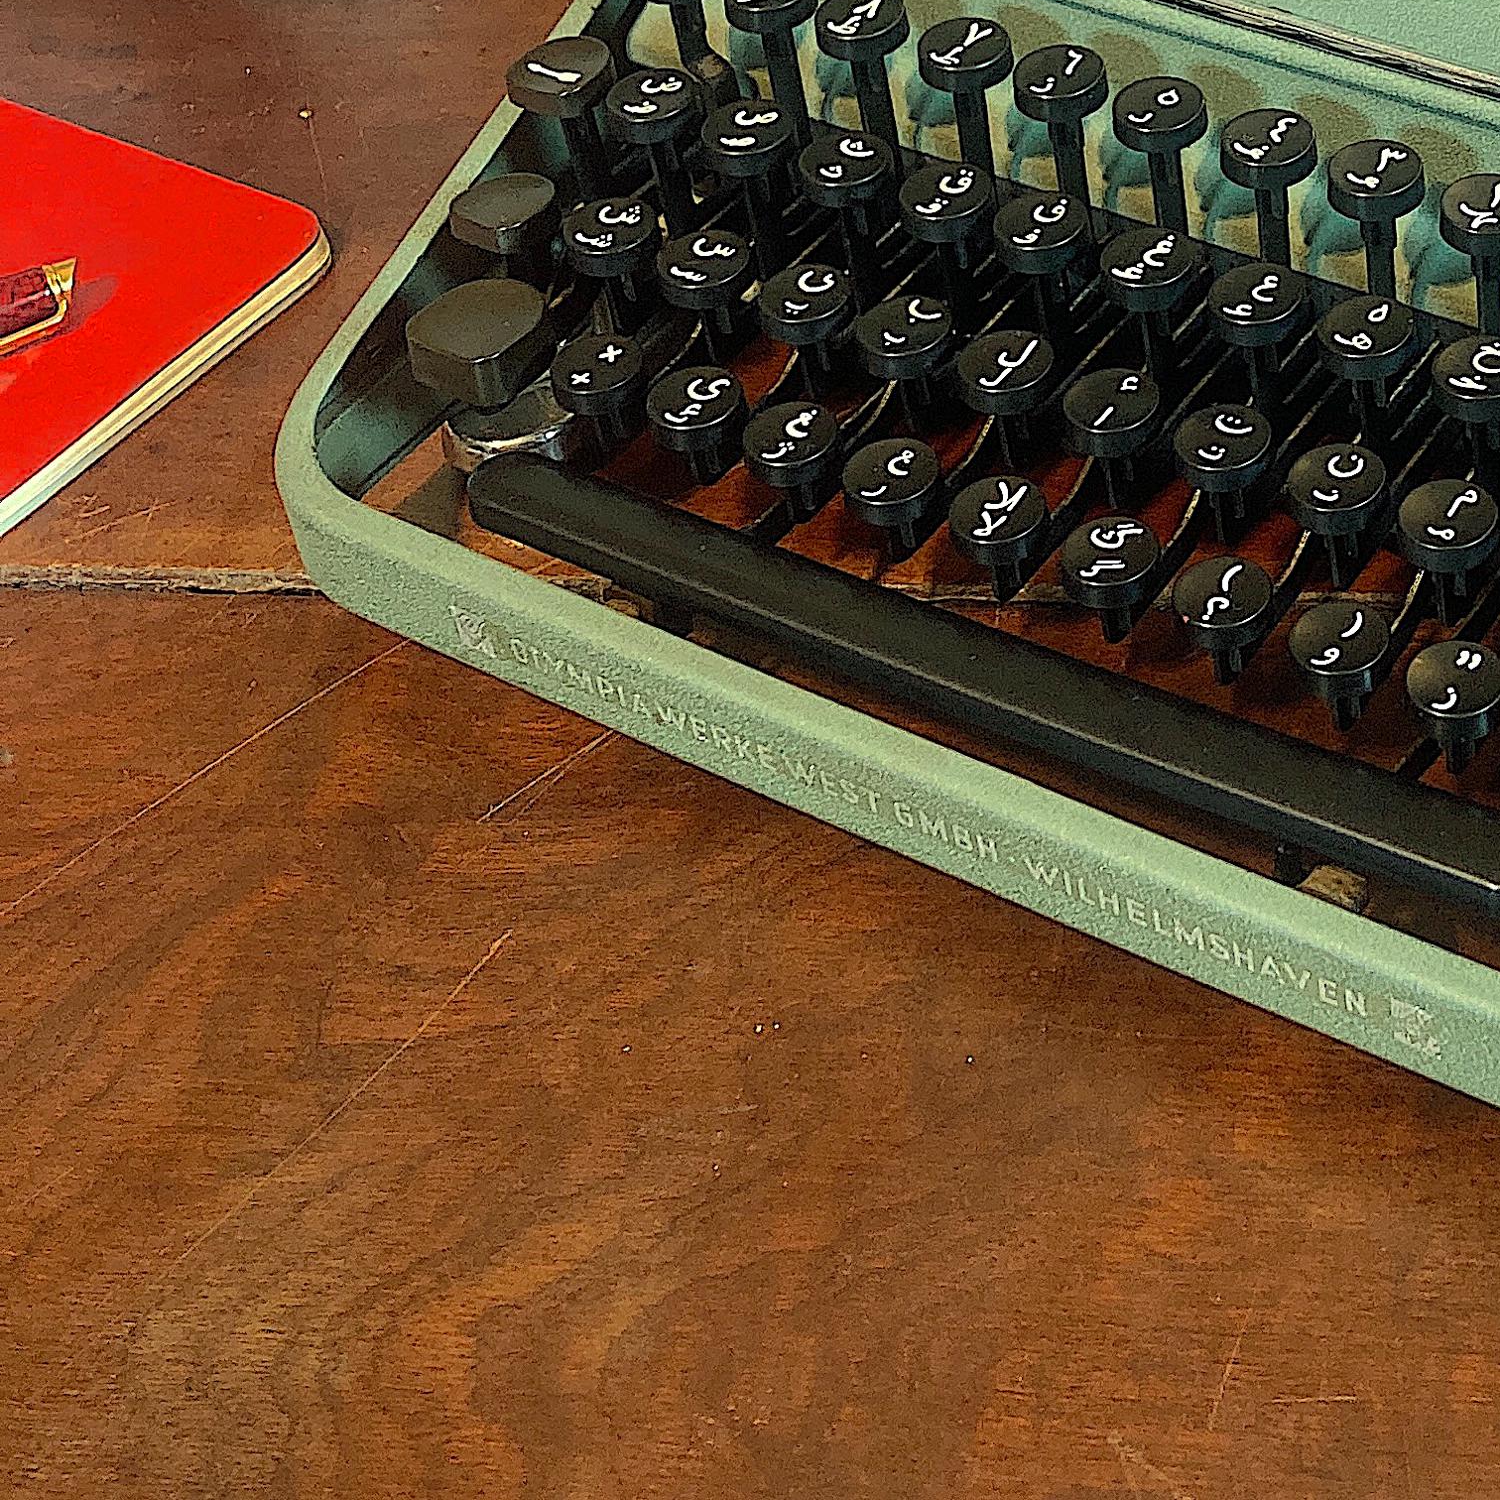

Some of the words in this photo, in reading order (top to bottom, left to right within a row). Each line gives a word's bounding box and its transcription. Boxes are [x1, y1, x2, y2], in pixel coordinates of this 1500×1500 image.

[656, 703, 779, 772] WERKE
[784, 756, 882, 817] WEST
[891, 799, 1000, 863] GMBH
[1023, 854, 1369, 1019] WILHELMSHAVEN
